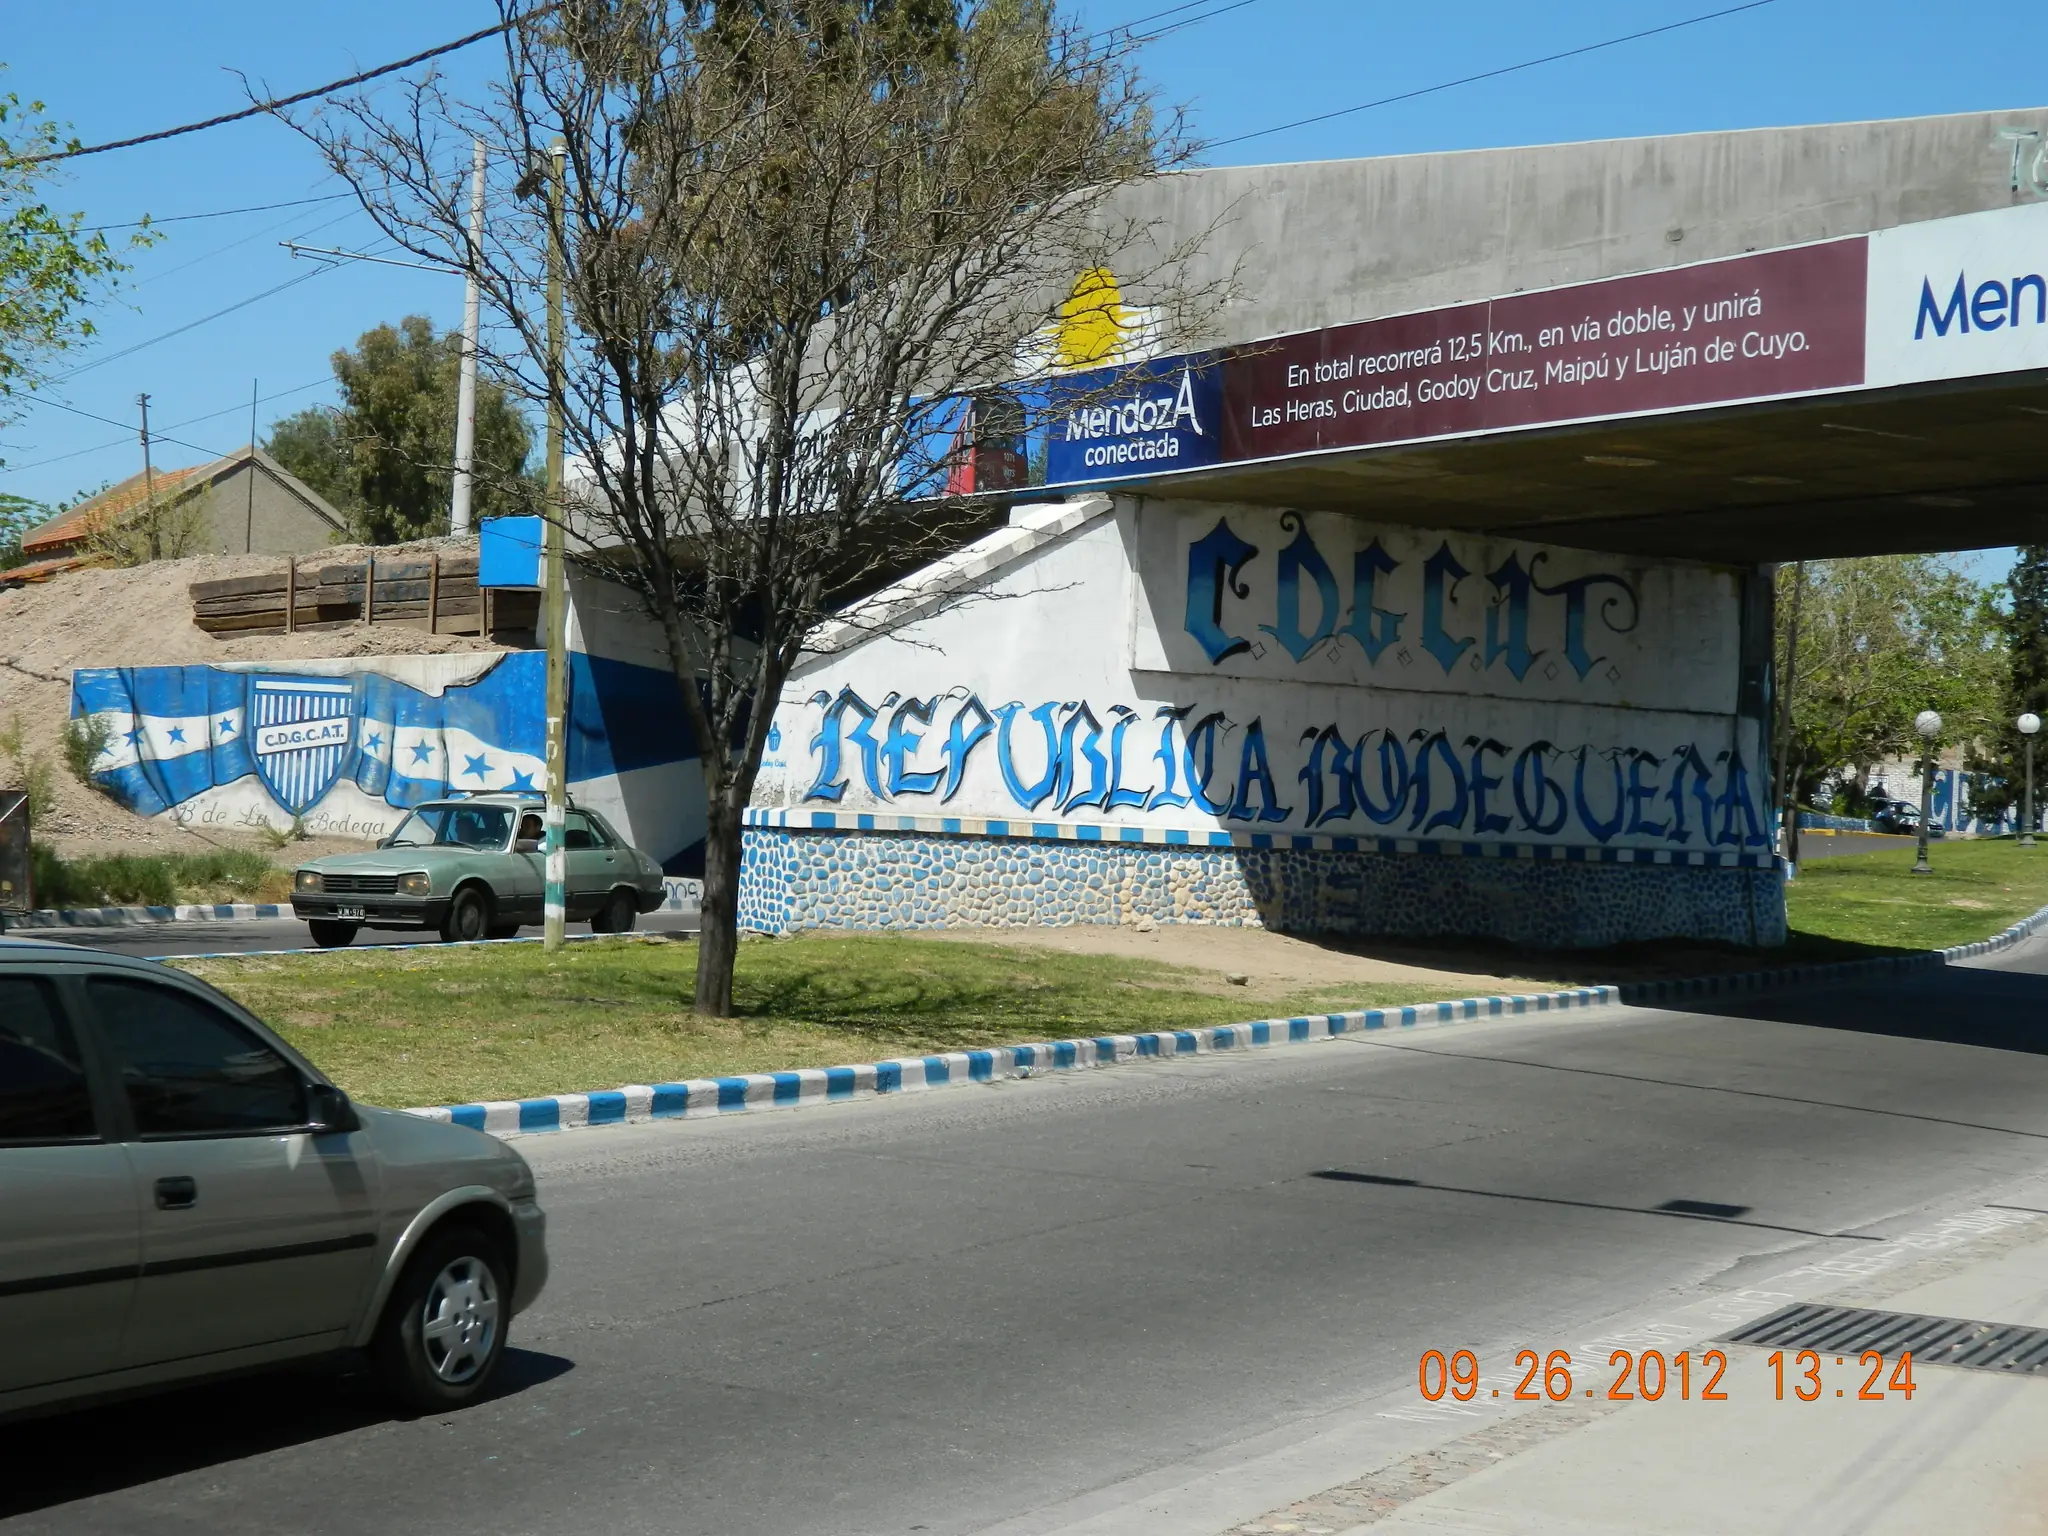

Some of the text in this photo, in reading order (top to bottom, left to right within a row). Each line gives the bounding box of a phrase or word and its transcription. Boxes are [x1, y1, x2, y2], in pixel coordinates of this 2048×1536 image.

[1287, 288, 1762, 388] En total recorrerá 12,5 Km., en vía doble, y unirá
[1252, 331, 1810, 428] Las Heras, Ciudad, Godoy Cruz, Maipú y Luján de Cuyo.
[1085, 432, 1180, 467] conectada
[264, 724, 344, 747] C.D.G.C.A.T.
[802, 684, 1768, 848] REPUBLICA BODEGUERA
[202, 802, 227, 824] de
